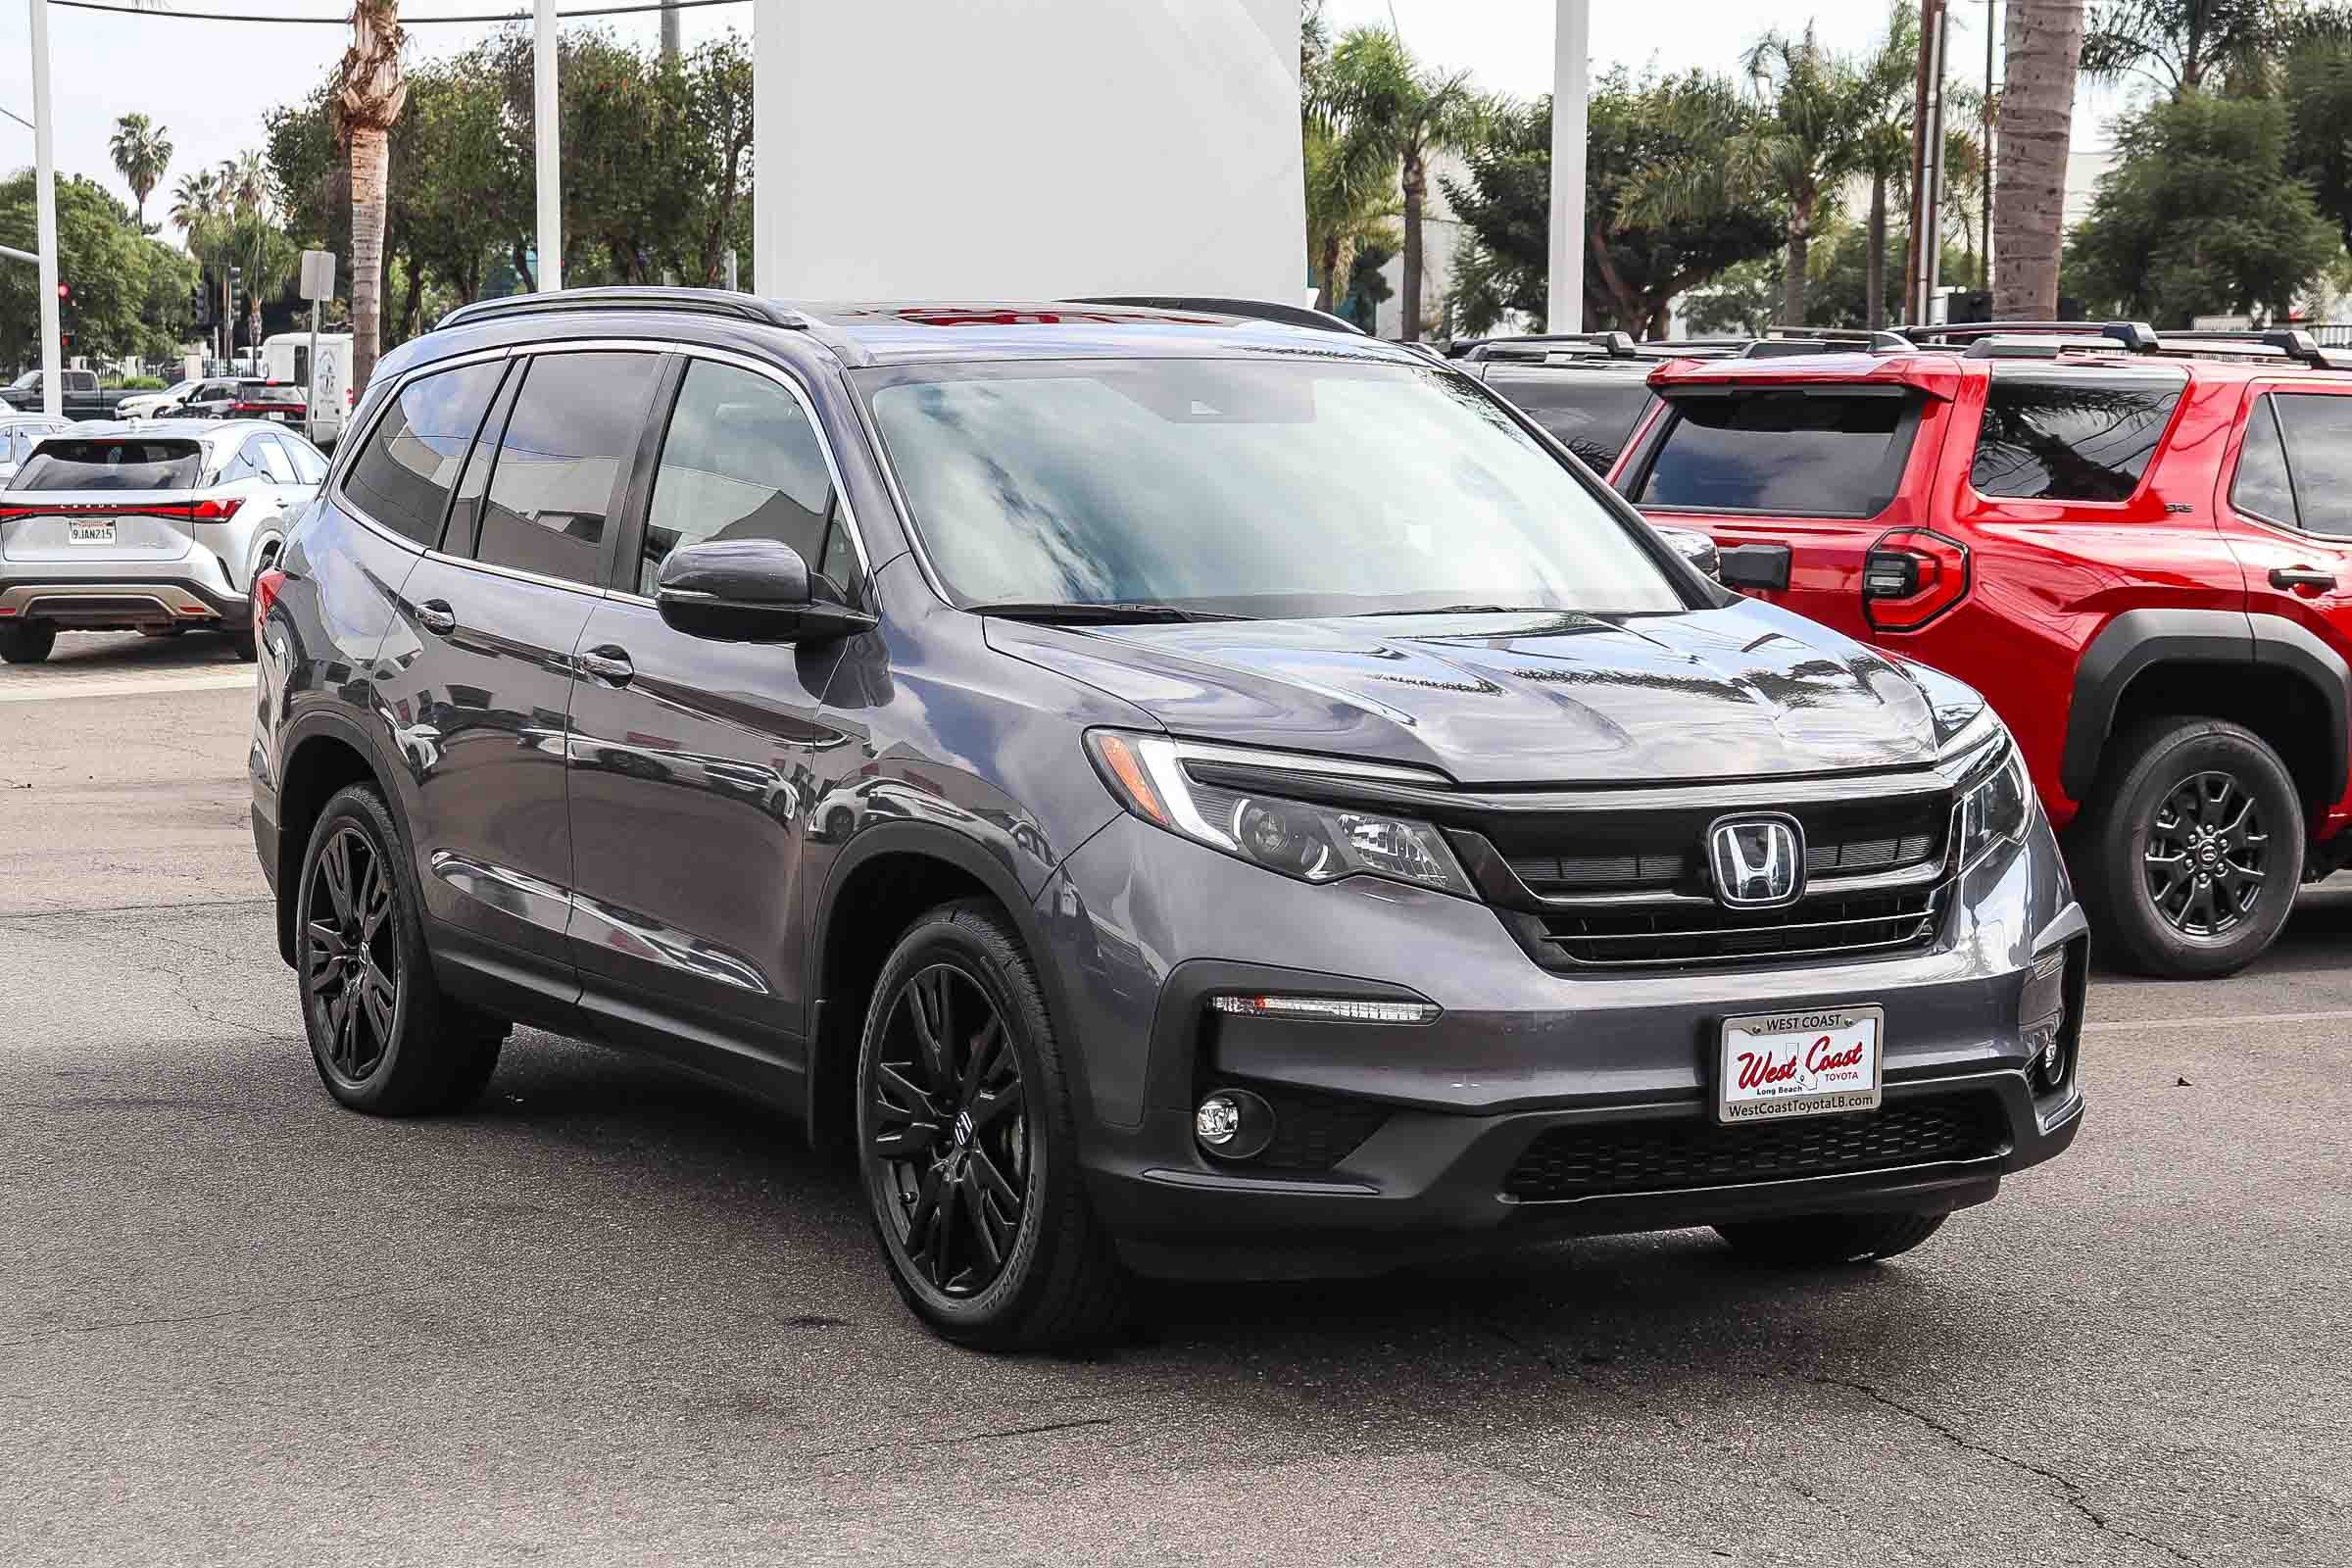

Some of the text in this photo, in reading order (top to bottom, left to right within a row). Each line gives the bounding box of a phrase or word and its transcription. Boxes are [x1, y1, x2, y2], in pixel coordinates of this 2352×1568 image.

[1766, 1013, 1841, 1031] WEST COAST
[1738, 1035, 1863, 1090] West Coast
[1825, 1071, 1859, 1082] TOYOTA
[1756, 1085, 1803, 1097] Long Beach
[1729, 1096, 1874, 1117] WestCoastToyotaLB.com
